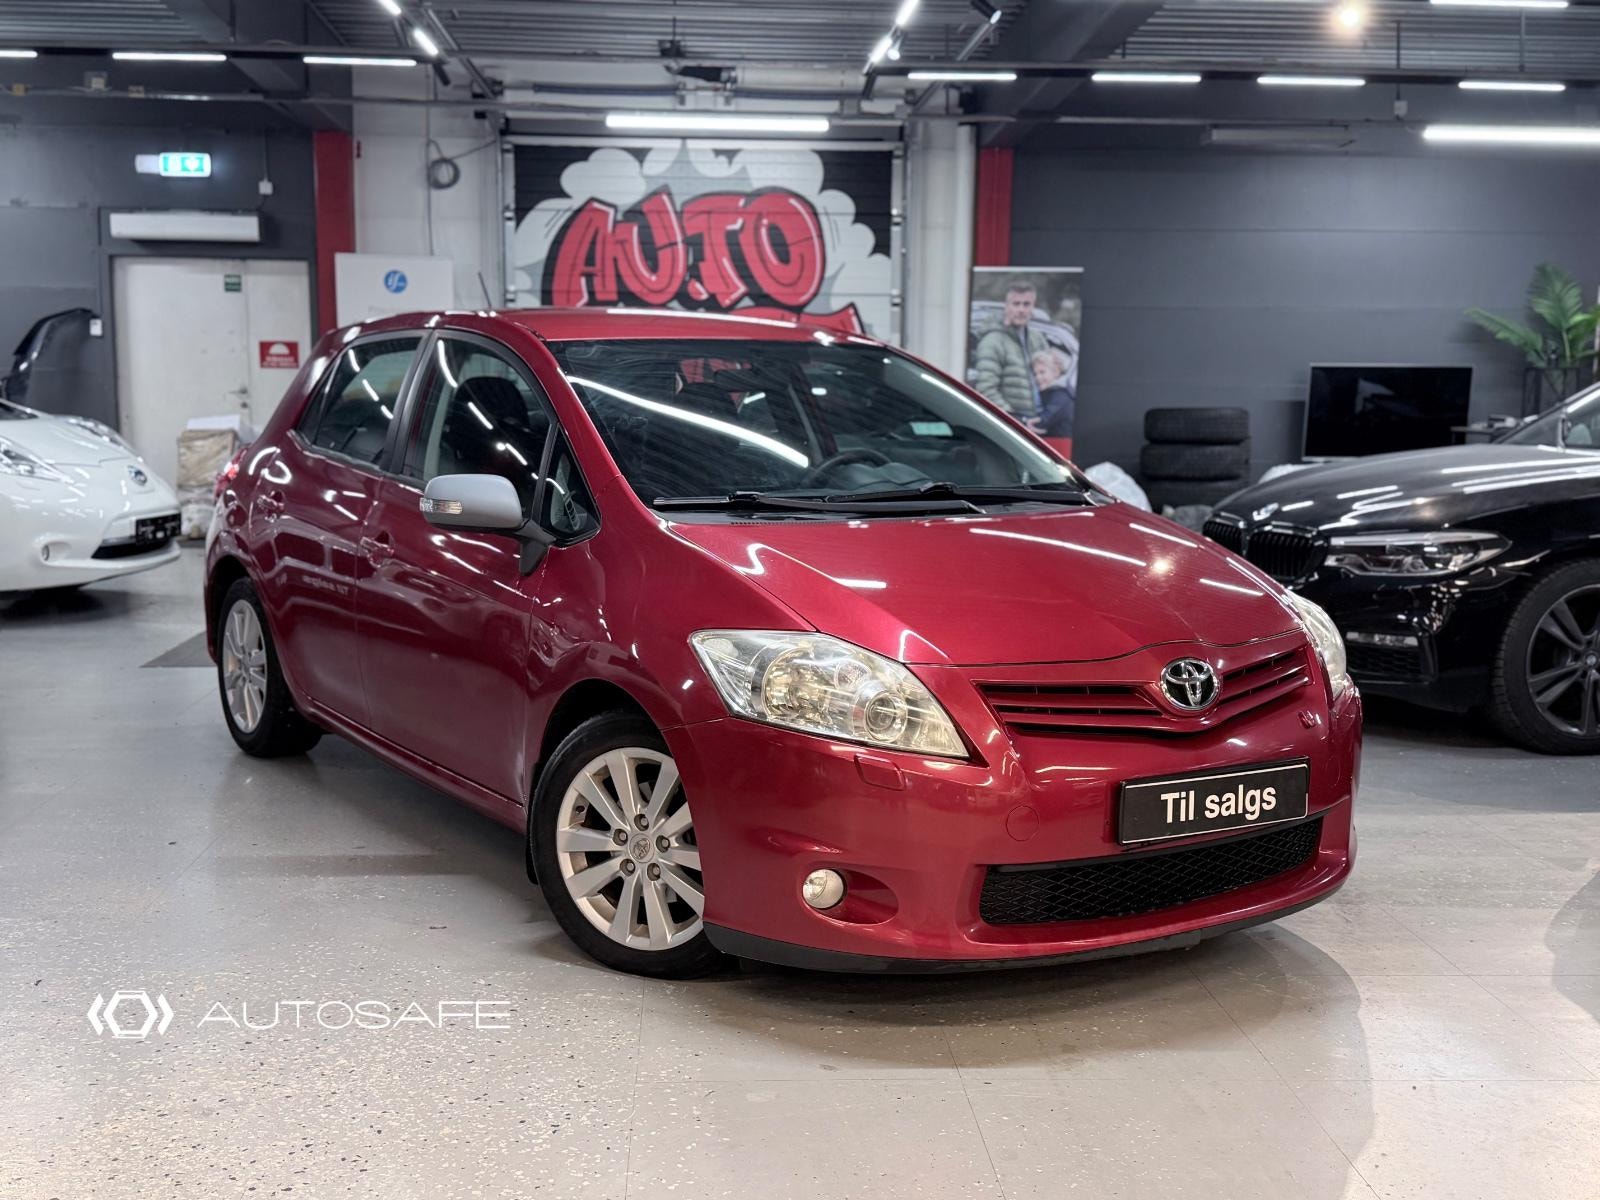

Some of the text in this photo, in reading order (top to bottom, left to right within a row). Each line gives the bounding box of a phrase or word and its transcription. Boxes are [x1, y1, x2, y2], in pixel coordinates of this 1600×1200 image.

[548, 186, 825, 308] AUTO
[1160, 784, 1277, 824] Til salgs
